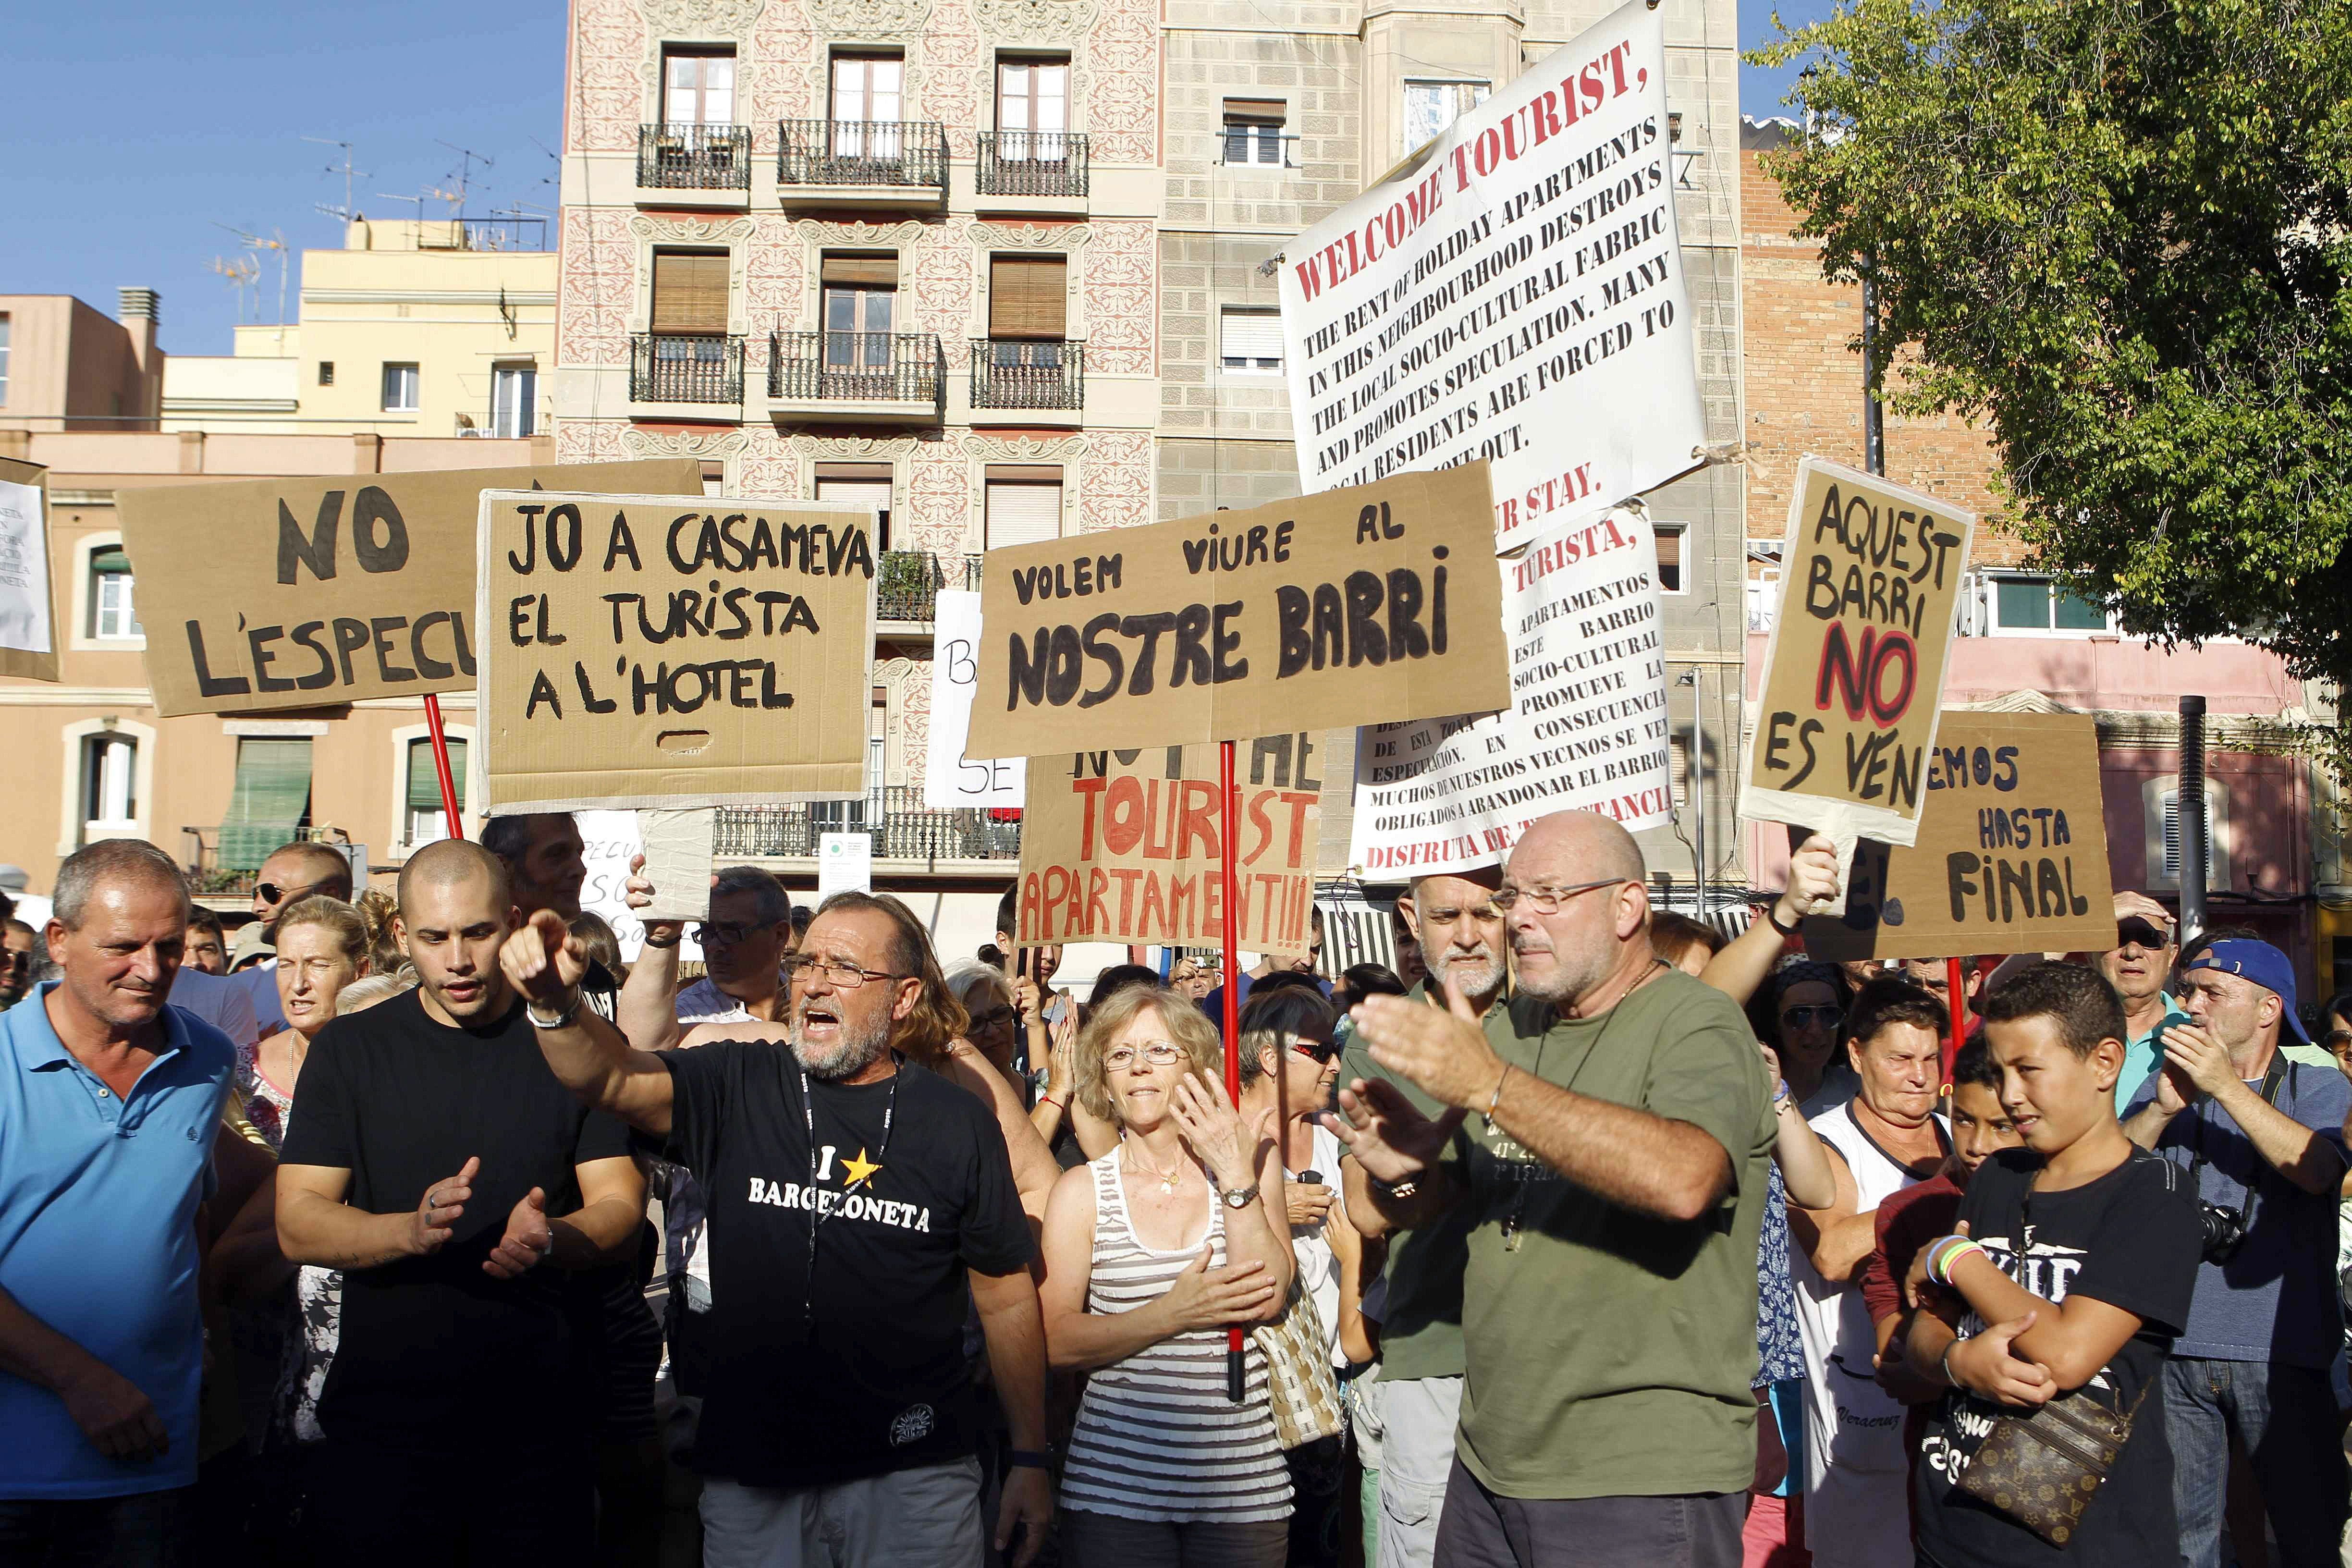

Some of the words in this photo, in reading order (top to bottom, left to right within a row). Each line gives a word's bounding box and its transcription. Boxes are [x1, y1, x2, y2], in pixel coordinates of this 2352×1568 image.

[1295, 163, 1443, 302] WELCOME
[1450, 40, 1647, 193] TOURIST,
[1304, 325, 1340, 359] THE
[1346, 293, 1390, 335] RENT
[1394, 273, 1410, 304] OF
[1415, 211, 1493, 284] HOLIDAY
[1501, 115, 1656, 228] APARTMENTS
[1309, 368, 1328, 398] IN
[1332, 345, 1373, 382] THIS
[1378, 234, 1533, 357] NEIGHBOURHOOD
[1541, 160, 1662, 252] DESTROYS
[1312, 400, 1348, 437] THE
[1351, 364, 1396, 413] LOCAL
[1400, 260, 1569, 379] SOCIO-CULTURAL
[1576, 205, 1667, 278] FABRIC
[1317, 438, 1349, 476] AND
[1354, 391, 1440, 454] PROMOTES
[1445, 294, 1593, 397] SPECULATION.
[1603, 251, 1671, 311] MANY
[1374, 401, 1478, 480] RESIDENTS
[1487, 375, 1531, 420] ARE
[1537, 323, 1632, 391] FORCED
[1641, 299, 1675, 338] TO
[1481, 423, 1529, 465] OUT.
[1526, 462, 1601, 521] STAY.
[277, 485, 409, 585] NO
[508, 503, 583, 575] JO
[603, 510, 642, 572] A
[1013, 553, 1123, 605] VOLEM
[1357, 501, 1405, 545] AL
[1513, 519, 1637, 593] TURISTA,
[1814, 483, 1961, 590] AQUEST
[509, 594, 567, 646] EL
[1519, 572, 1650, 637] APARTAMENTOS
[1806, 554, 1925, 639] BARRI
[1007, 600, 1249, 711] NOSTRE
[1513, 630, 1660, 692] SOCIO-CULTURAL
[1515, 637, 1544, 665] ESTE
[1579, 601, 1655, 639] BARRIO
[526, 669, 562, 720] A
[576, 654, 795, 716] L'HOTEL
[1521, 671, 1627, 716] PROMUEVE
[1646, 660, 1663, 680] LA
[1815, 620, 1917, 729] NO
[1371, 785, 1435, 807] MUCHOS
[1436, 780, 1449, 798] DE
[1446, 757, 1526, 795] NUESTROS
[1530, 739, 1611, 774] VECINOS
[1615, 727, 1637, 747] SE
[1372, 746, 1465, 782] ESPECULACIÓN.
[1485, 734, 1507, 754] EN
[1374, 740, 1396, 758] DE
[1410, 729, 1433, 751] ESTA
[1440, 715, 1475, 740] ZONA
[1764, 711, 1824, 791] ES
[1847, 727, 1921, 808] VEN
[1927, 746, 2019, 792] EMOS
[1375, 805, 1456, 832] OBLIGADOS
[1456, 802, 1465, 819] A
[1468, 775, 1575, 816] ABANDONAR
[1579, 767, 1601, 787] EL
[1979, 807, 2070, 849] HASTA
[1366, 835, 1481, 869] DISFRUTA
[1482, 824, 1516, 852] DE
[816, 1145, 836, 1180] I
[748, 1177, 930, 1233] BARCELONETA
[1837, 1406, 1900, 1430] Veracruz
